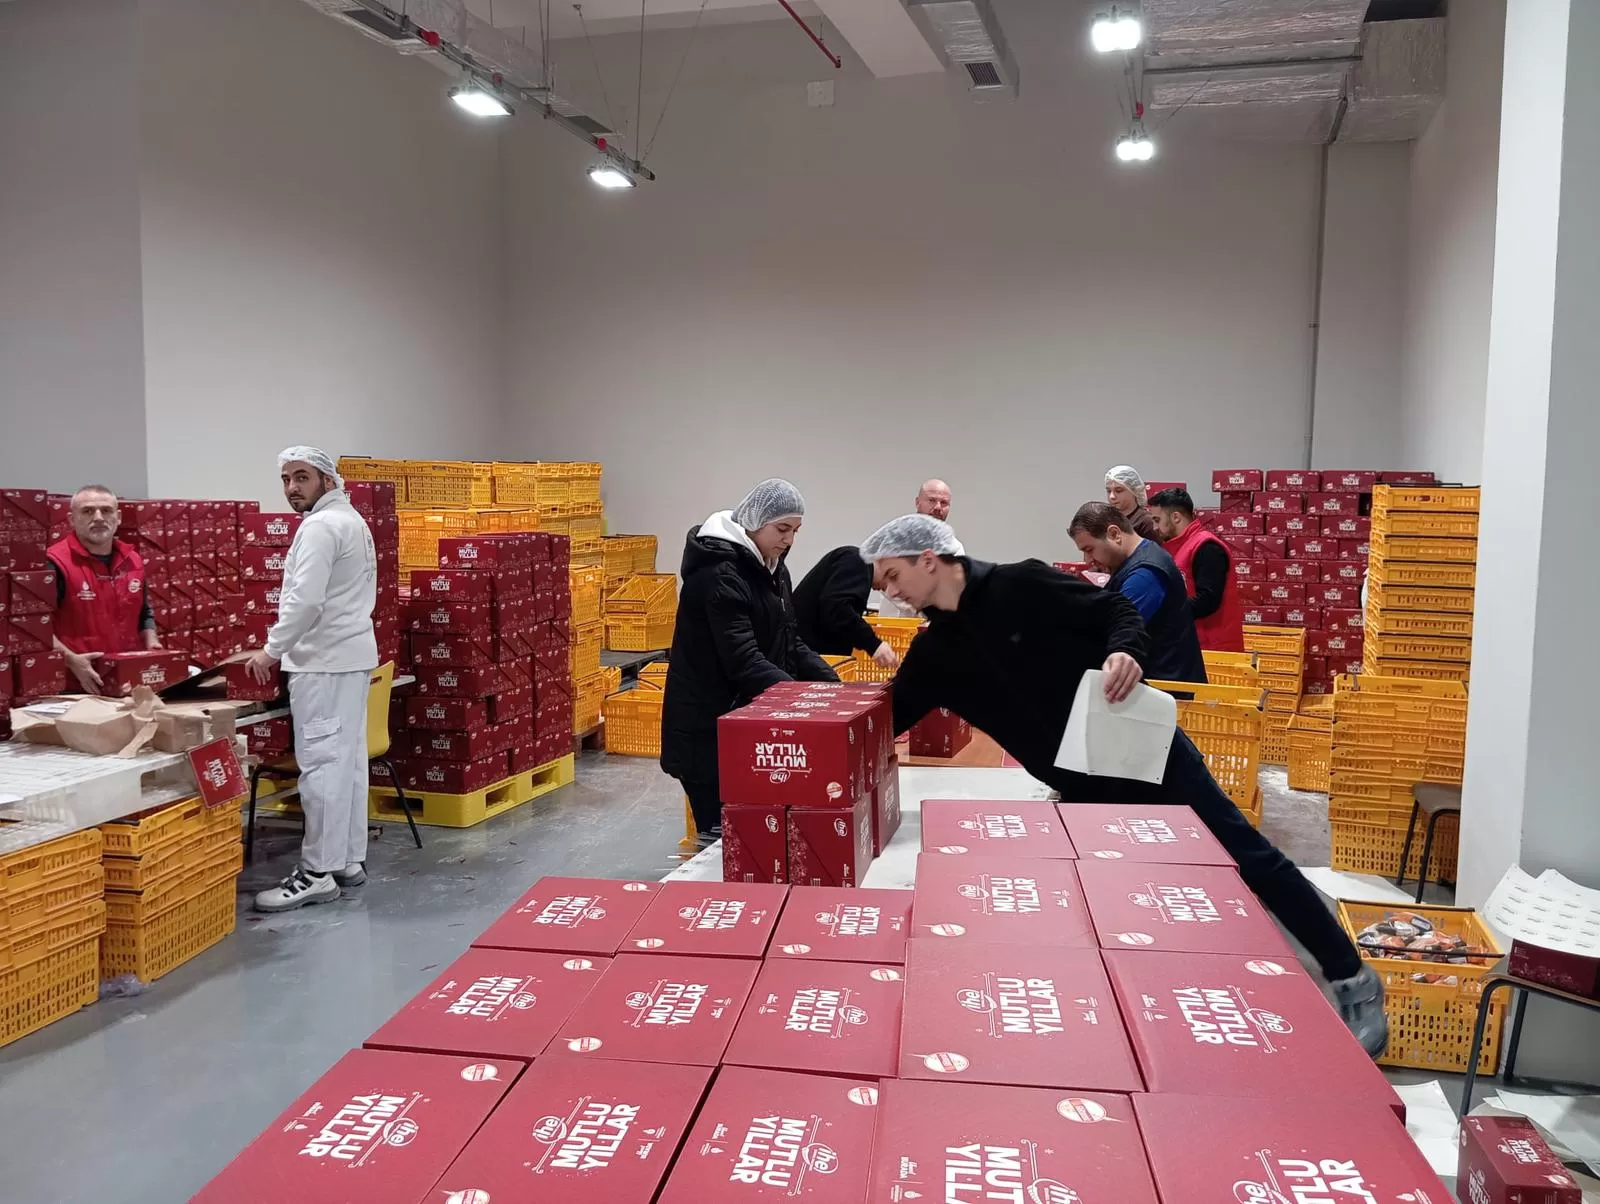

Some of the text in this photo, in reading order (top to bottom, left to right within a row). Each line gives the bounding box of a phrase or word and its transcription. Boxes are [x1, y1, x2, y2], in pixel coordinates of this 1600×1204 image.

[755, 743, 807, 755] YILLAR
[756, 754, 806, 768] MUTLU
[985, 816, 1007, 837] MUTLU
[1004, 815, 1027, 837] YILLAR
[1127, 820, 1158, 842] MUTLU
[1147, 820, 1178, 842] YILLAR
[533, 897, 573, 923] YILLAR
[553, 897, 591, 924] MUTLU
[991, 878, 1016, 911] MUTLU
[1014, 879, 1040, 912] YILLAR
[1158, 887, 1197, 920] MUTLU
[1182, 888, 1222, 922] YILLAR
[697, 901, 727, 928] MUTLU
[716, 901, 746, 929] YILLAR
[838, 907, 861, 934] MUTLU
[859, 907, 880, 935] YILLAR
[446, 977, 501, 1014] YILLAR
[470, 978, 522, 1016] MUTLU
[645, 984, 685, 1023] MUTLU
[668, 985, 708, 1024] YILLAR
[785, 989, 817, 1030] YILLAR
[810, 991, 839, 1032] MUTLU
[998, 978, 1032, 1032] MUTLU
[1028, 979, 1063, 1033] YILLAR
[1173, 988, 1224, 1043] YILLAR
[1202, 989, 1257, 1045] MUTLU
[299, 1094, 381, 1156] YILLAR
[330, 1096, 406, 1159] MUTLU
[550, 1103, 611, 1167] MUTLU
[578, 1105, 640, 1169] YILLAR
[730, 1117, 779, 1183] YILLAR
[762, 1119, 807, 1186] MUTLU
